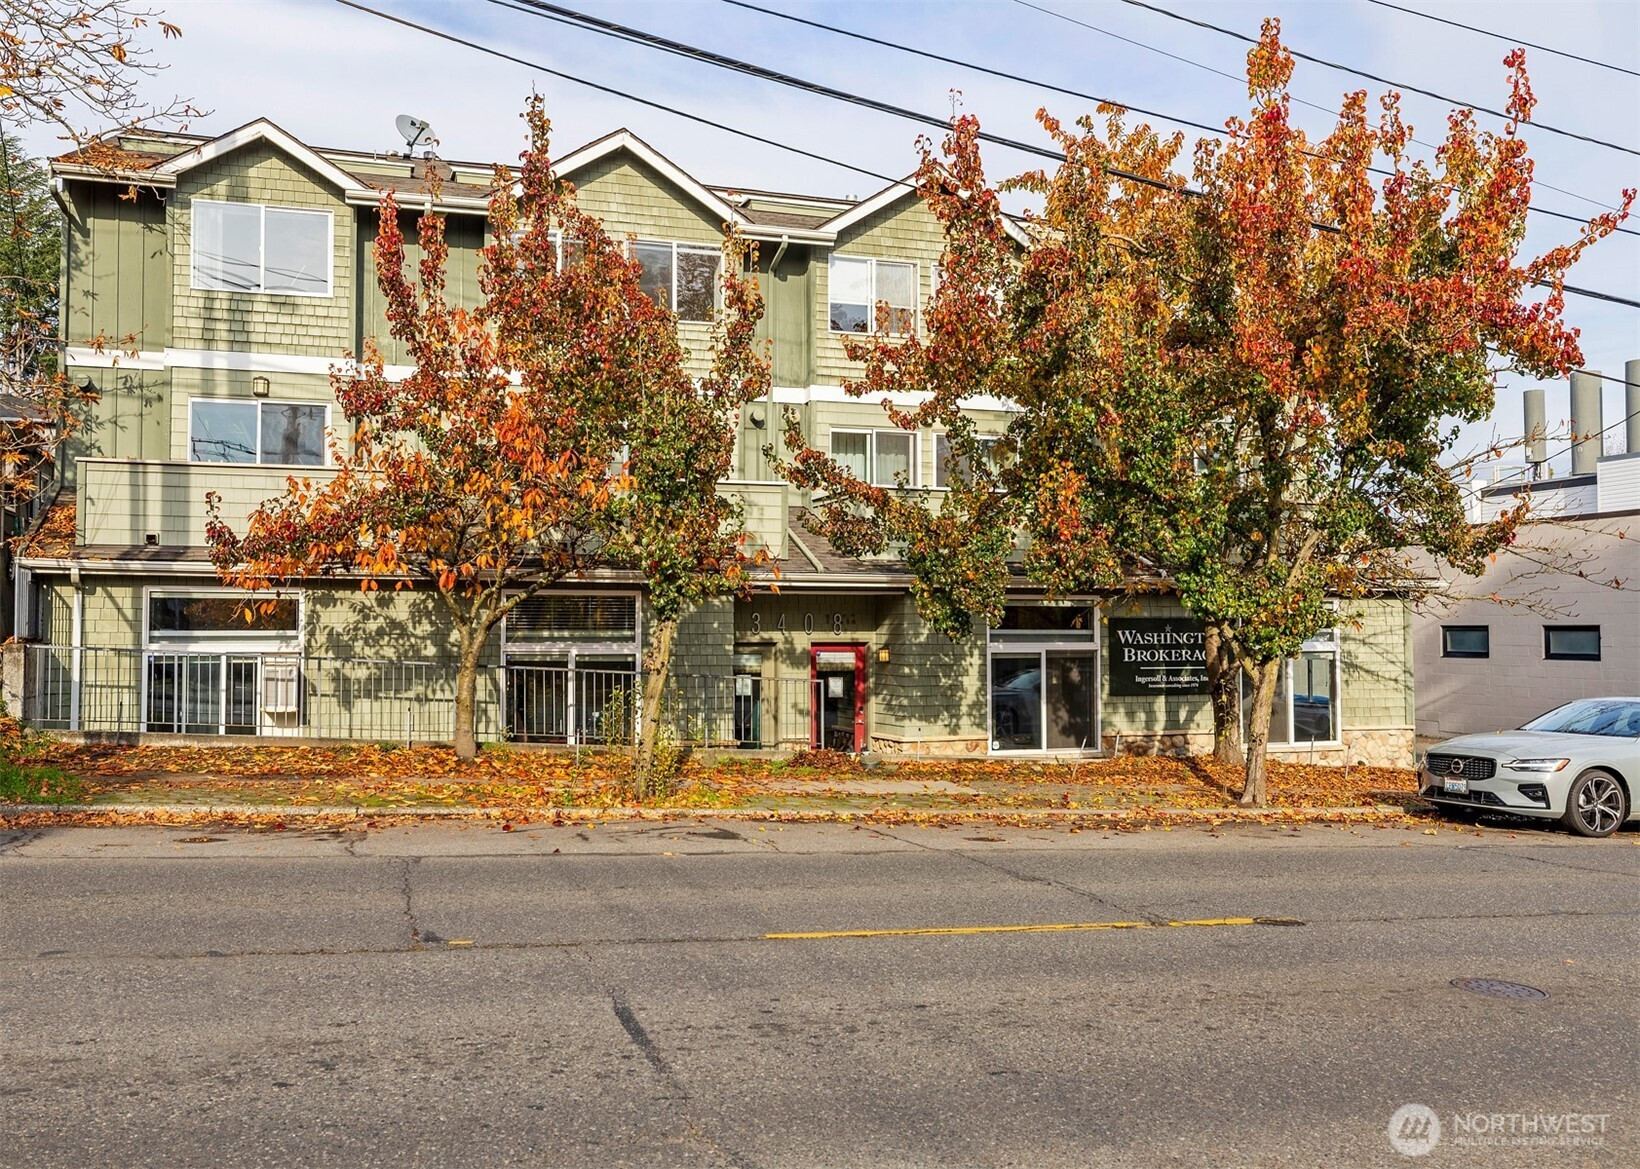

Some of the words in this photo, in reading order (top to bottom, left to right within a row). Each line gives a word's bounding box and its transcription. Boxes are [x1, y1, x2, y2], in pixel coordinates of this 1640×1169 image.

[752, 612, 842, 635] 3408
[1117, 630, 1205, 645] WASHINGT
[1123, 647, 1206, 662] BROKERA
[1135, 675, 1161, 684] Ingersoll
[1168, 675, 1199, 683] Associates,
